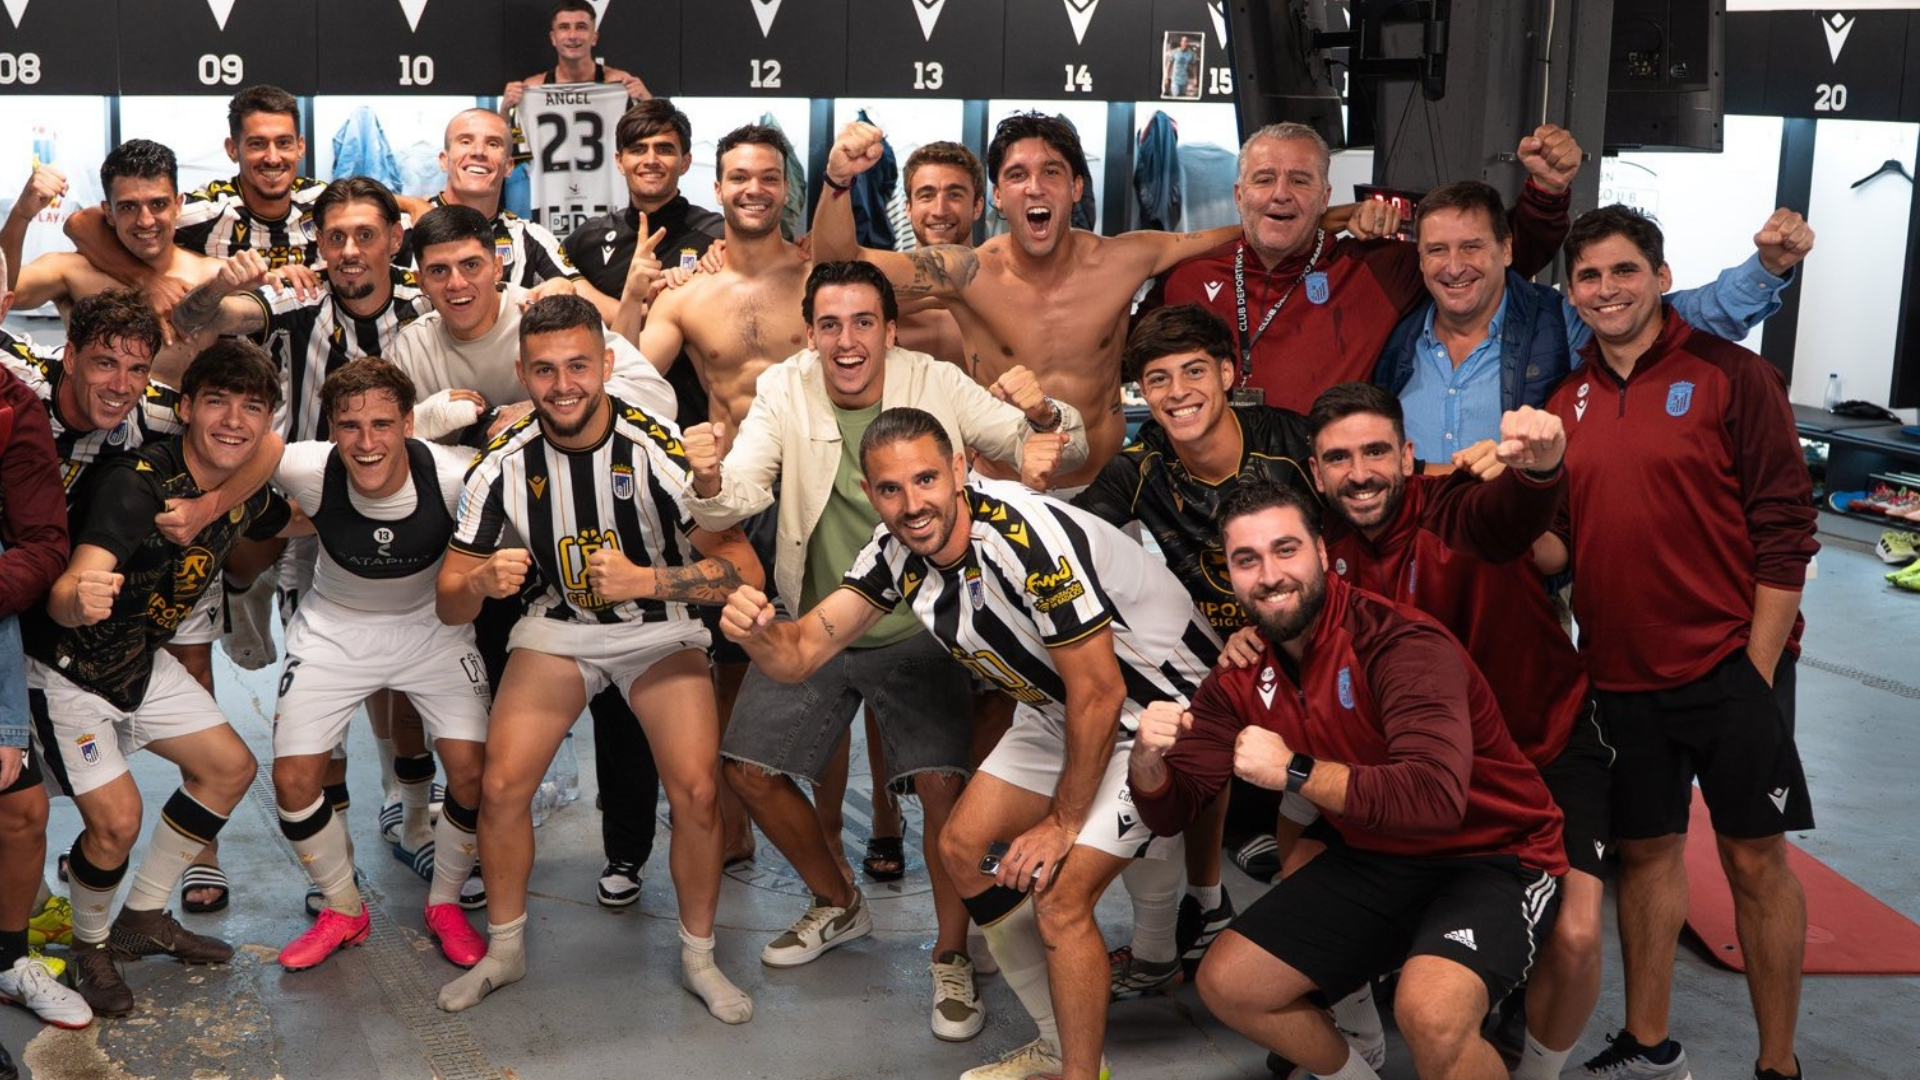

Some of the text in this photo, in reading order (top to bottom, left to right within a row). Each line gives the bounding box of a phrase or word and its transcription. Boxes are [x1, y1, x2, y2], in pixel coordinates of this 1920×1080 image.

[0, 53, 41, 85] 08
[198, 54, 244, 85] 09
[399, 55, 434, 86] 10
[750, 59, 781, 88] 12
[914, 62, 943, 89] 13
[1064, 65, 1092, 92] 14
[1209, 67, 1232, 94] 15
[546, 92, 591, 106] ANGEL
[1814, 84, 1847, 111] 20
[537, 111, 605, 173] 23
[1235, 254, 1245, 305] DEPORTIVO
[1238, 307, 1248, 332] CLUB
[1258, 308, 1278, 332] CLUB
[377, 531, 391, 541] 13
